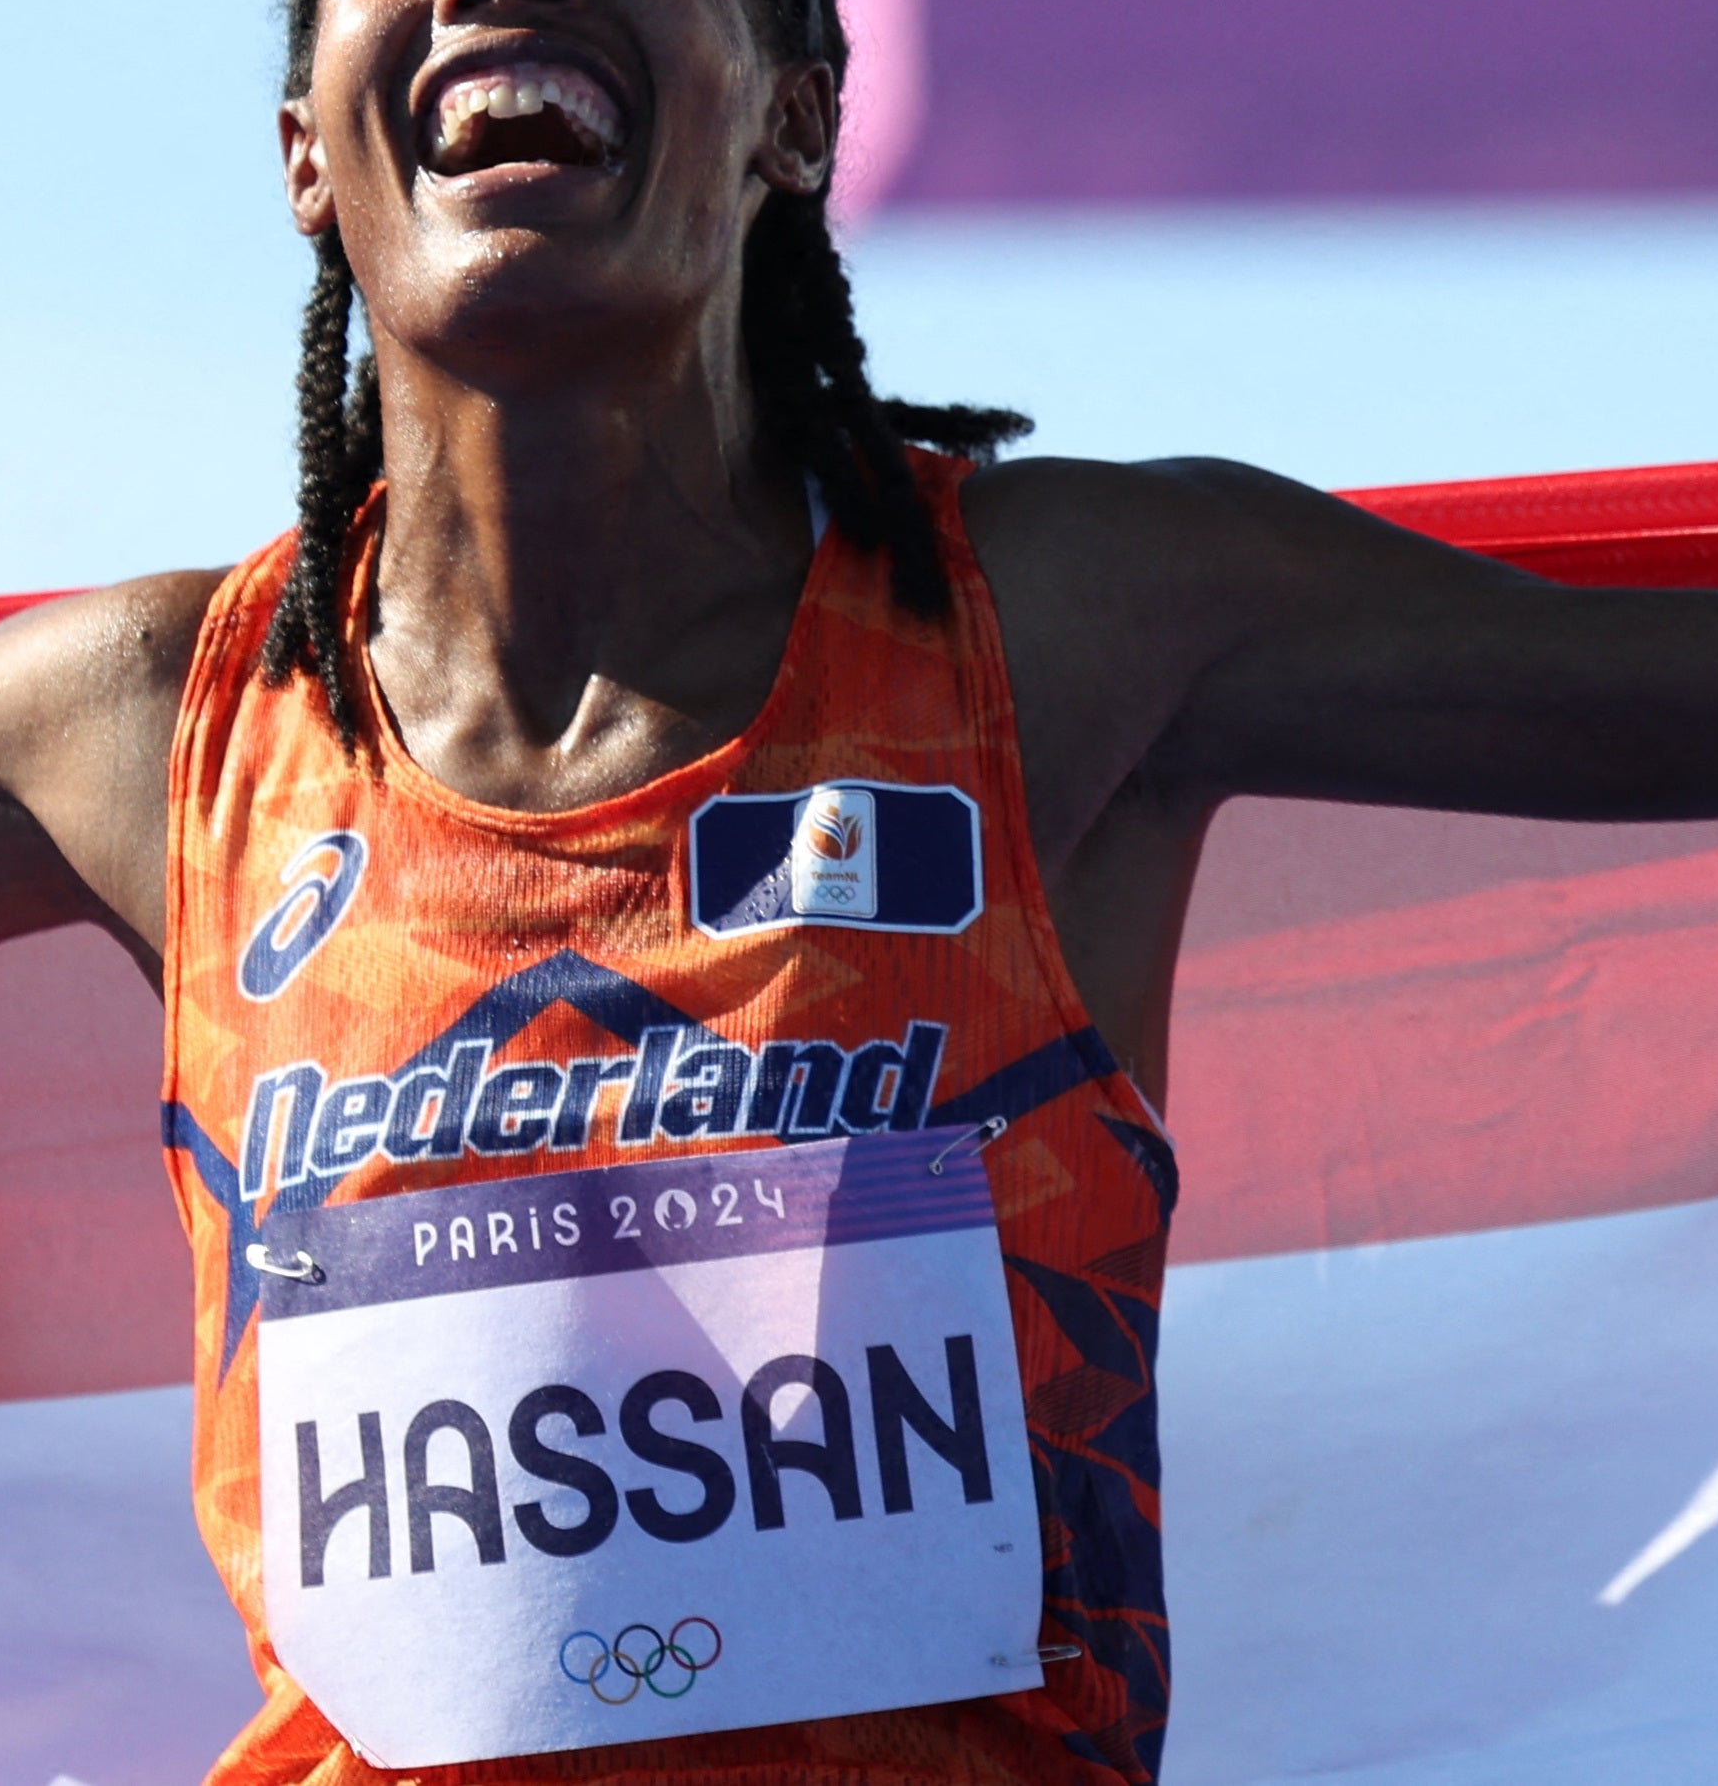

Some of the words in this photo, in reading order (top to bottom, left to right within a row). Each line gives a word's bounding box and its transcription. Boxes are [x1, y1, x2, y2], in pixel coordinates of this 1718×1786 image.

[810, 870, 860, 883] TeamNL
[610, 1179, 786, 1240] 2024
[294, 1333, 994, 1589] HASSAN
